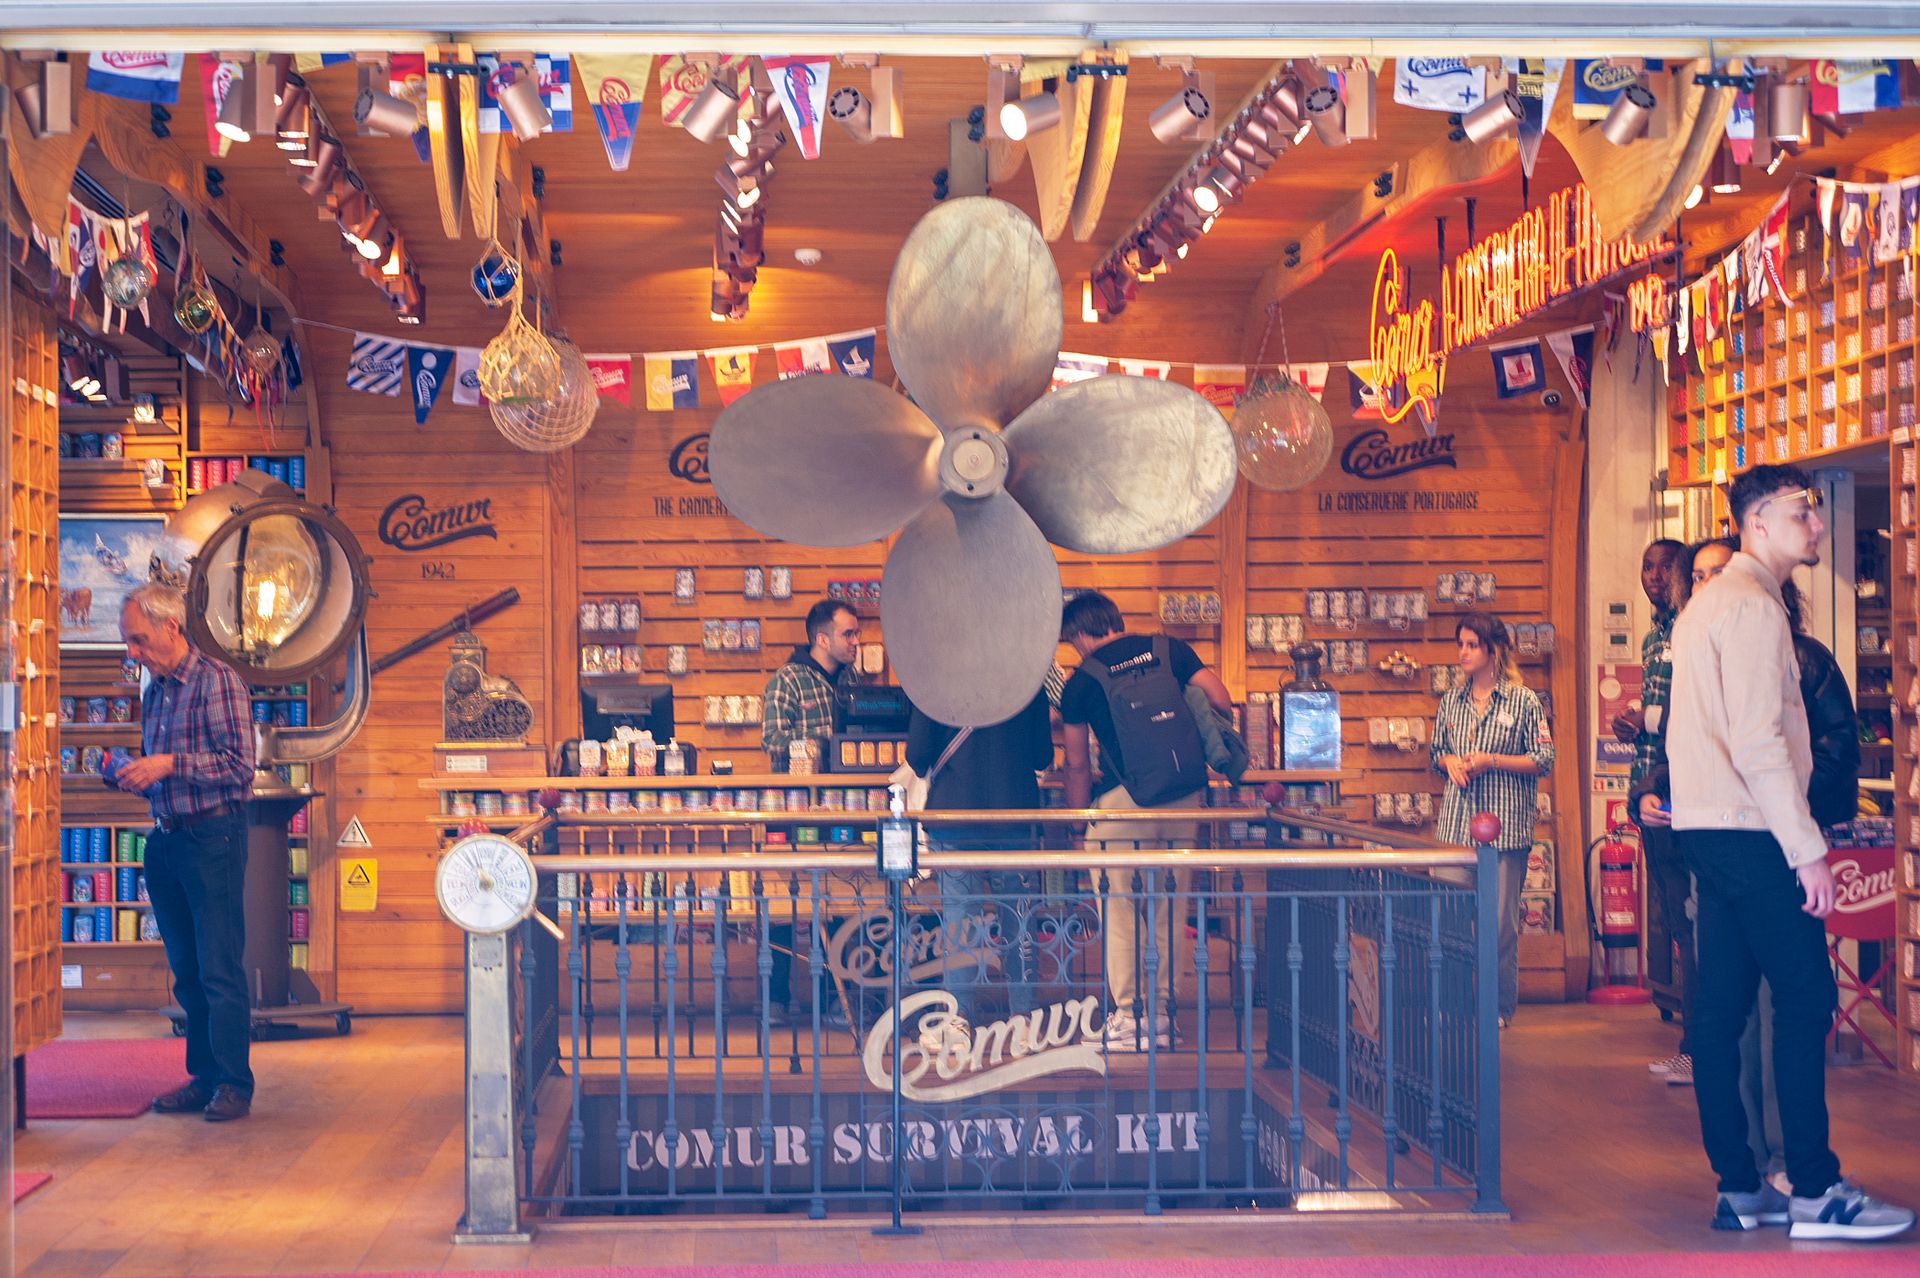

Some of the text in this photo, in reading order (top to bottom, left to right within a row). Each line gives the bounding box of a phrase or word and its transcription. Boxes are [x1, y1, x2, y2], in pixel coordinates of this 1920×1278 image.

[1340, 429, 1457, 480] Comur
[378, 493, 498, 551] Comur
[653, 496, 673, 517] THE
[421, 560, 455, 580] 1942
[864, 990, 1107, 1103] Comur
[626, 1125, 810, 1171] COMUR
[833, 1115, 1093, 1164] SURVIVAL
[1115, 1111, 1208, 1153] KIT
